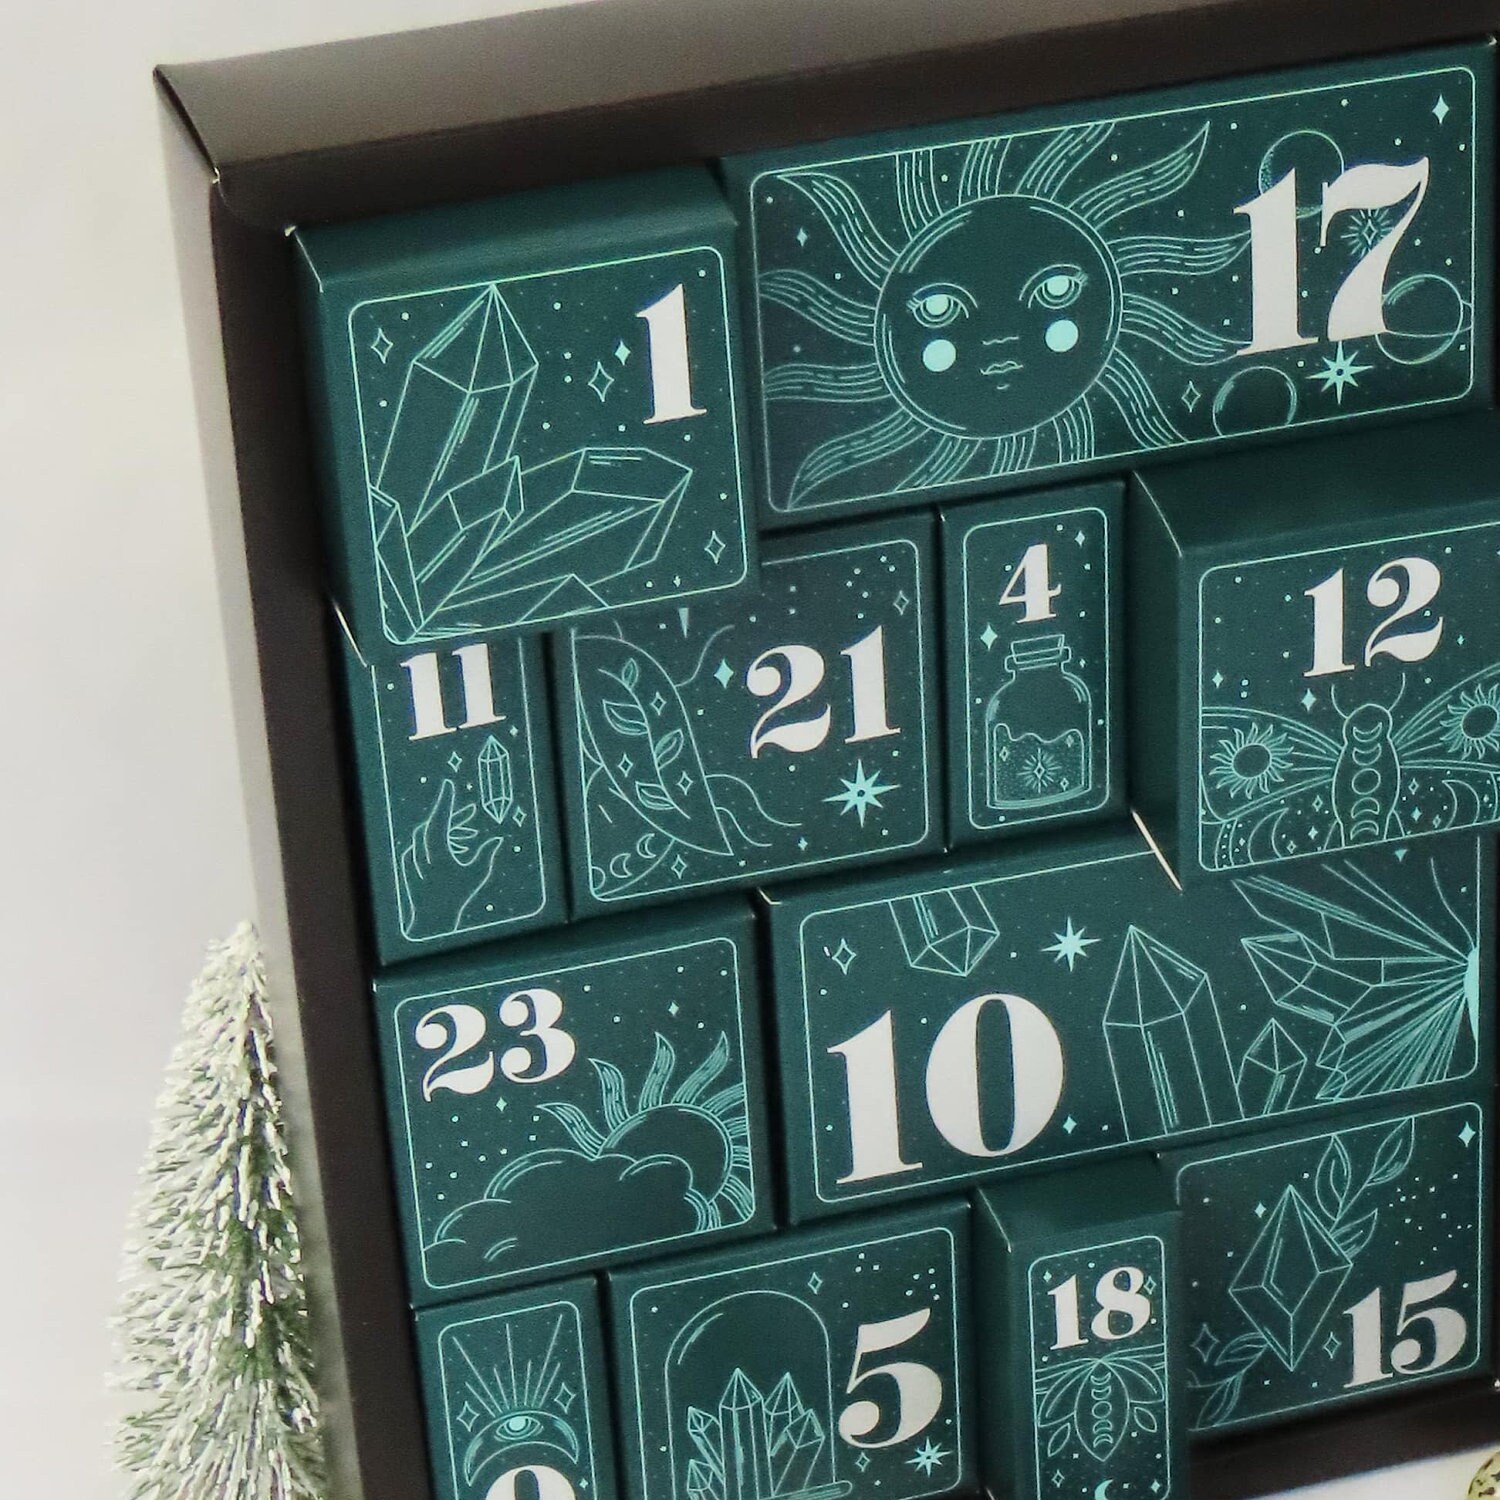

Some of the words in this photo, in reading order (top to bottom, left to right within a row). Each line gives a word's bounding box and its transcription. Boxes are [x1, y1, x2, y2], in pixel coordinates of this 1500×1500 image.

[1233, 156, 1430, 356] 17
[636, 284, 707, 424] 1
[999, 544, 1061, 623] 4
[1304, 557, 1443, 676] 12
[400, 643, 506, 741] 11
[747, 625, 900, 758] 21
[416, 989, 575, 1101] 23
[827, 993, 1063, 1184] 10
[1048, 1267, 1150, 1350] 18
[1343, 1270, 1466, 1388] 15
[838, 1308, 942, 1448] 5
